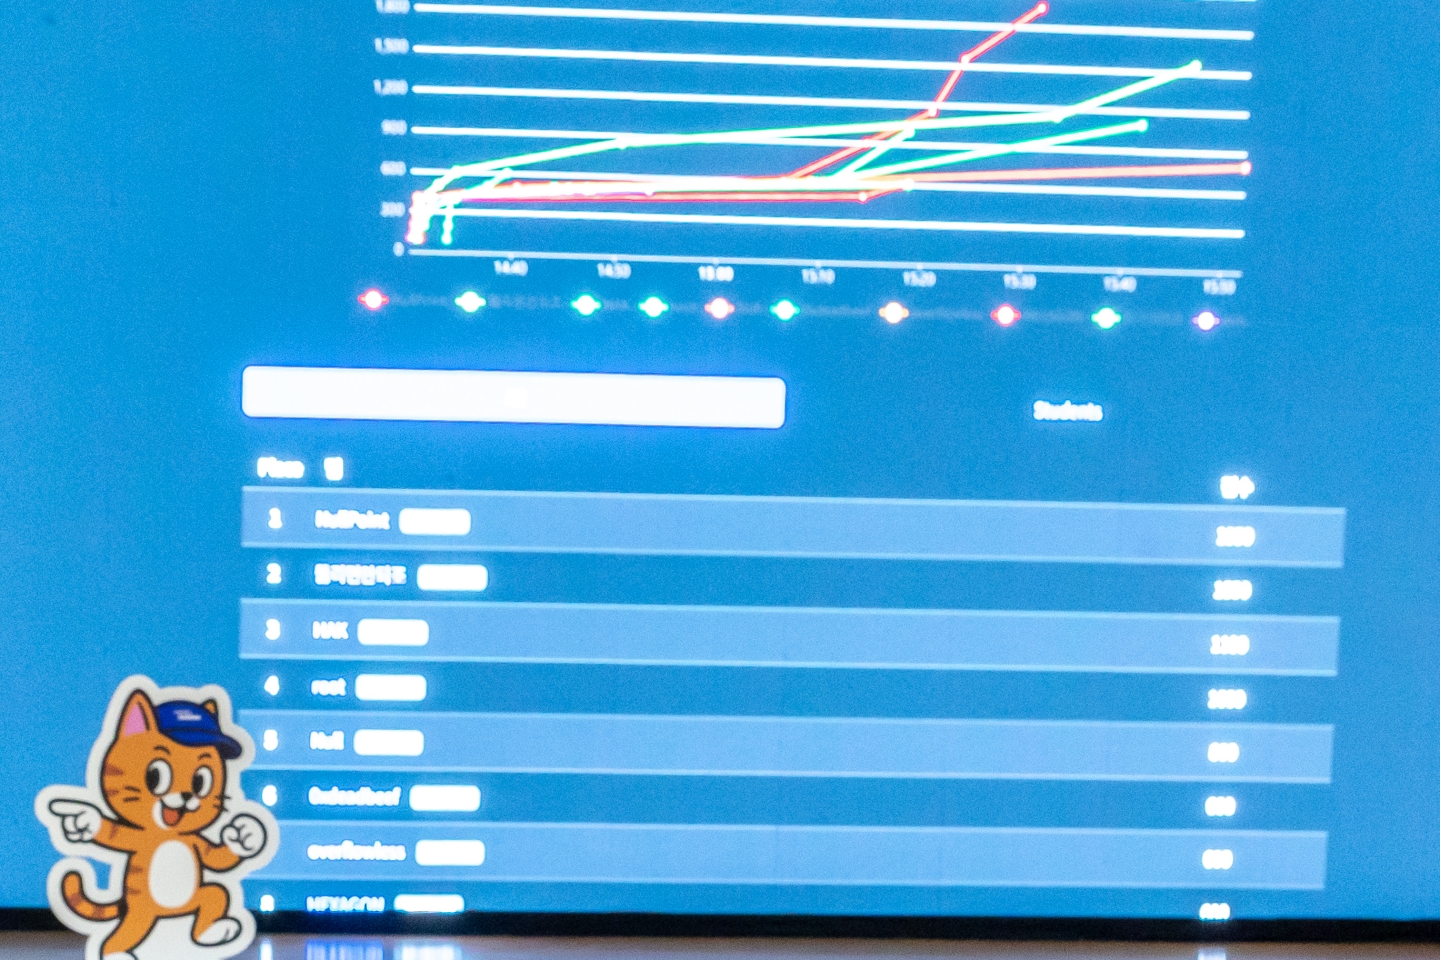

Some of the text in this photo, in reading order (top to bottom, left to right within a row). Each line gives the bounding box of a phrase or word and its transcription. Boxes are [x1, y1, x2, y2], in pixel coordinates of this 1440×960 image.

[268, 507, 282, 529] 1
[266, 563, 282, 584] 2
[265, 618, 281, 640] 3
[264, 675, 280, 696] 4
[263, 729, 278, 751] 5
[262, 784, 278, 806] 6
